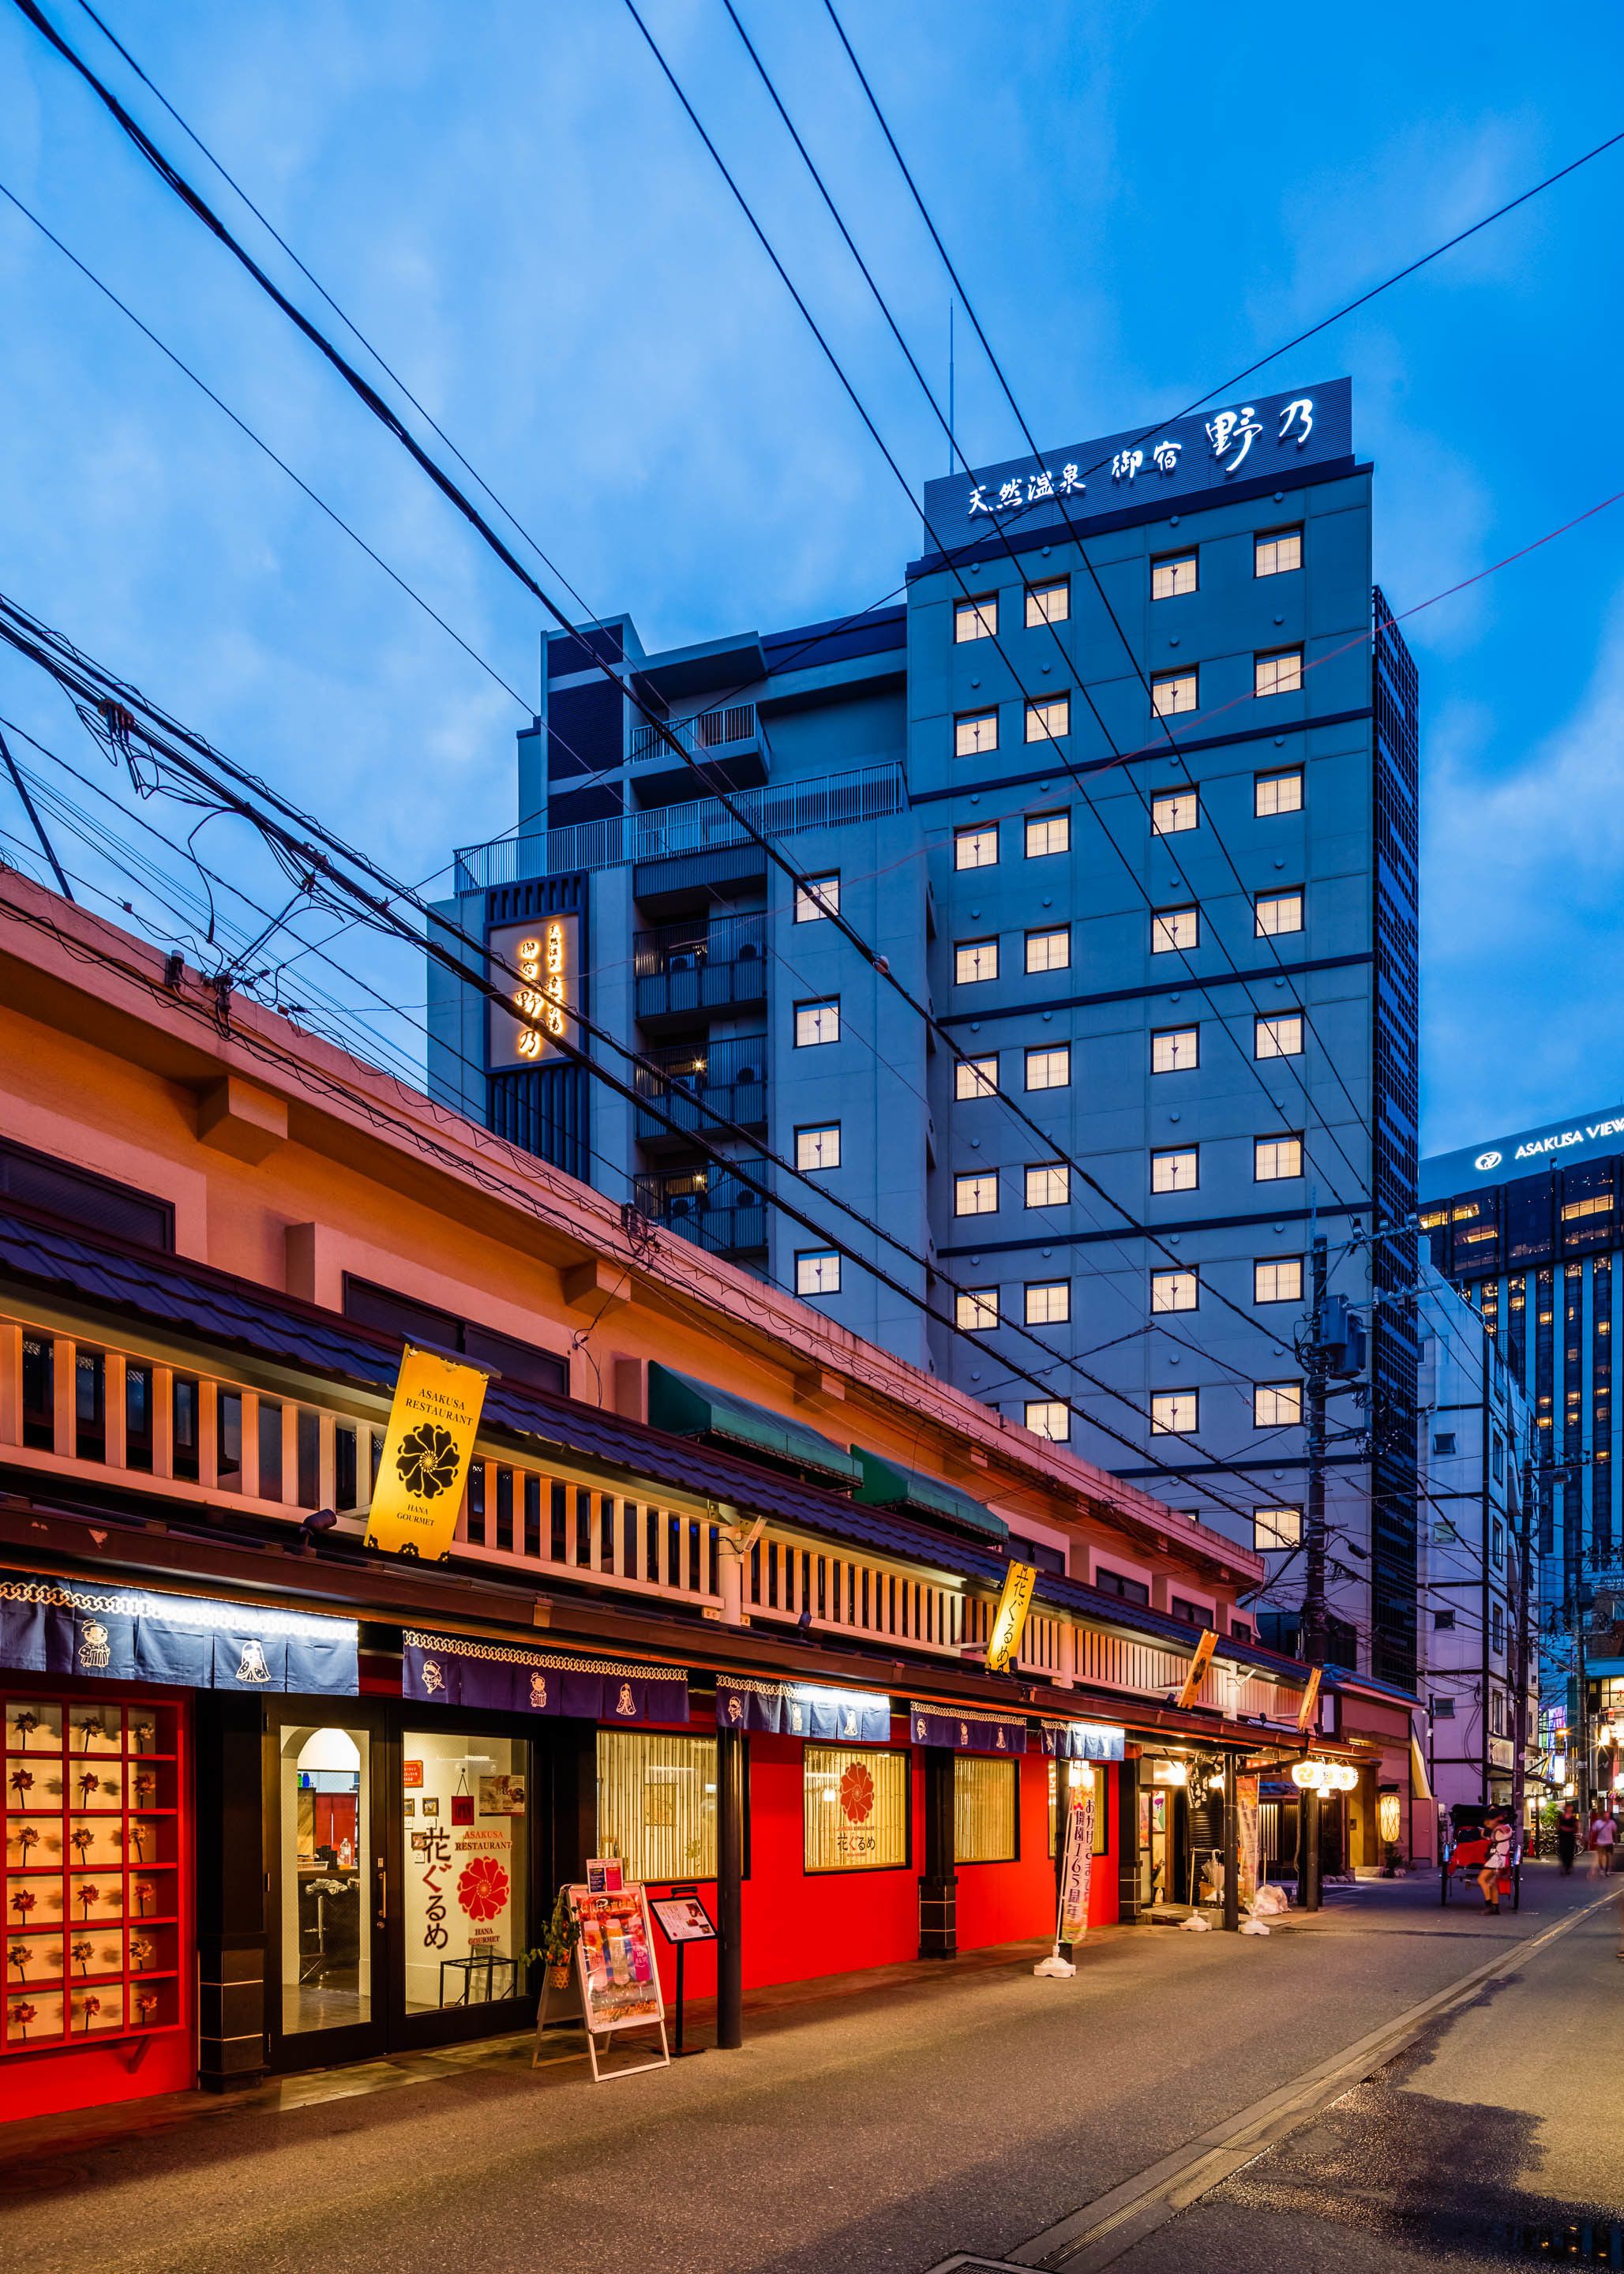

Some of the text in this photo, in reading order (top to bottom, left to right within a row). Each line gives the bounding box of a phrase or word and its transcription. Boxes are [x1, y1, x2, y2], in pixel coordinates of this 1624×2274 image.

[968, 398, 1314, 516] 天然温泉 御宿 野乃
[516, 940, 542, 1055] 御宿 野乃
[1514, 1130, 1585, 1161] ASAKUSA
[418, 1387, 466, 1411] ASAKUSA
[405, 1398, 474, 1426] RESTAURANT
[396, 1511, 436, 1527] GOURMET
[407, 1503, 429, 1515] HANA
[996, 1570, 1029, 1664] 花ぐるめ
[464, 1830, 503, 1839] ASAKUSA
[837, 1832, 876, 1852] 花ぐるめ
[455, 1841, 512, 1851] RESTAURANT
[422, 1826, 452, 1949] 花ぐるめ
[467, 1934, 501, 1946] GOURMET
[474, 1927, 493, 1936] HANA
